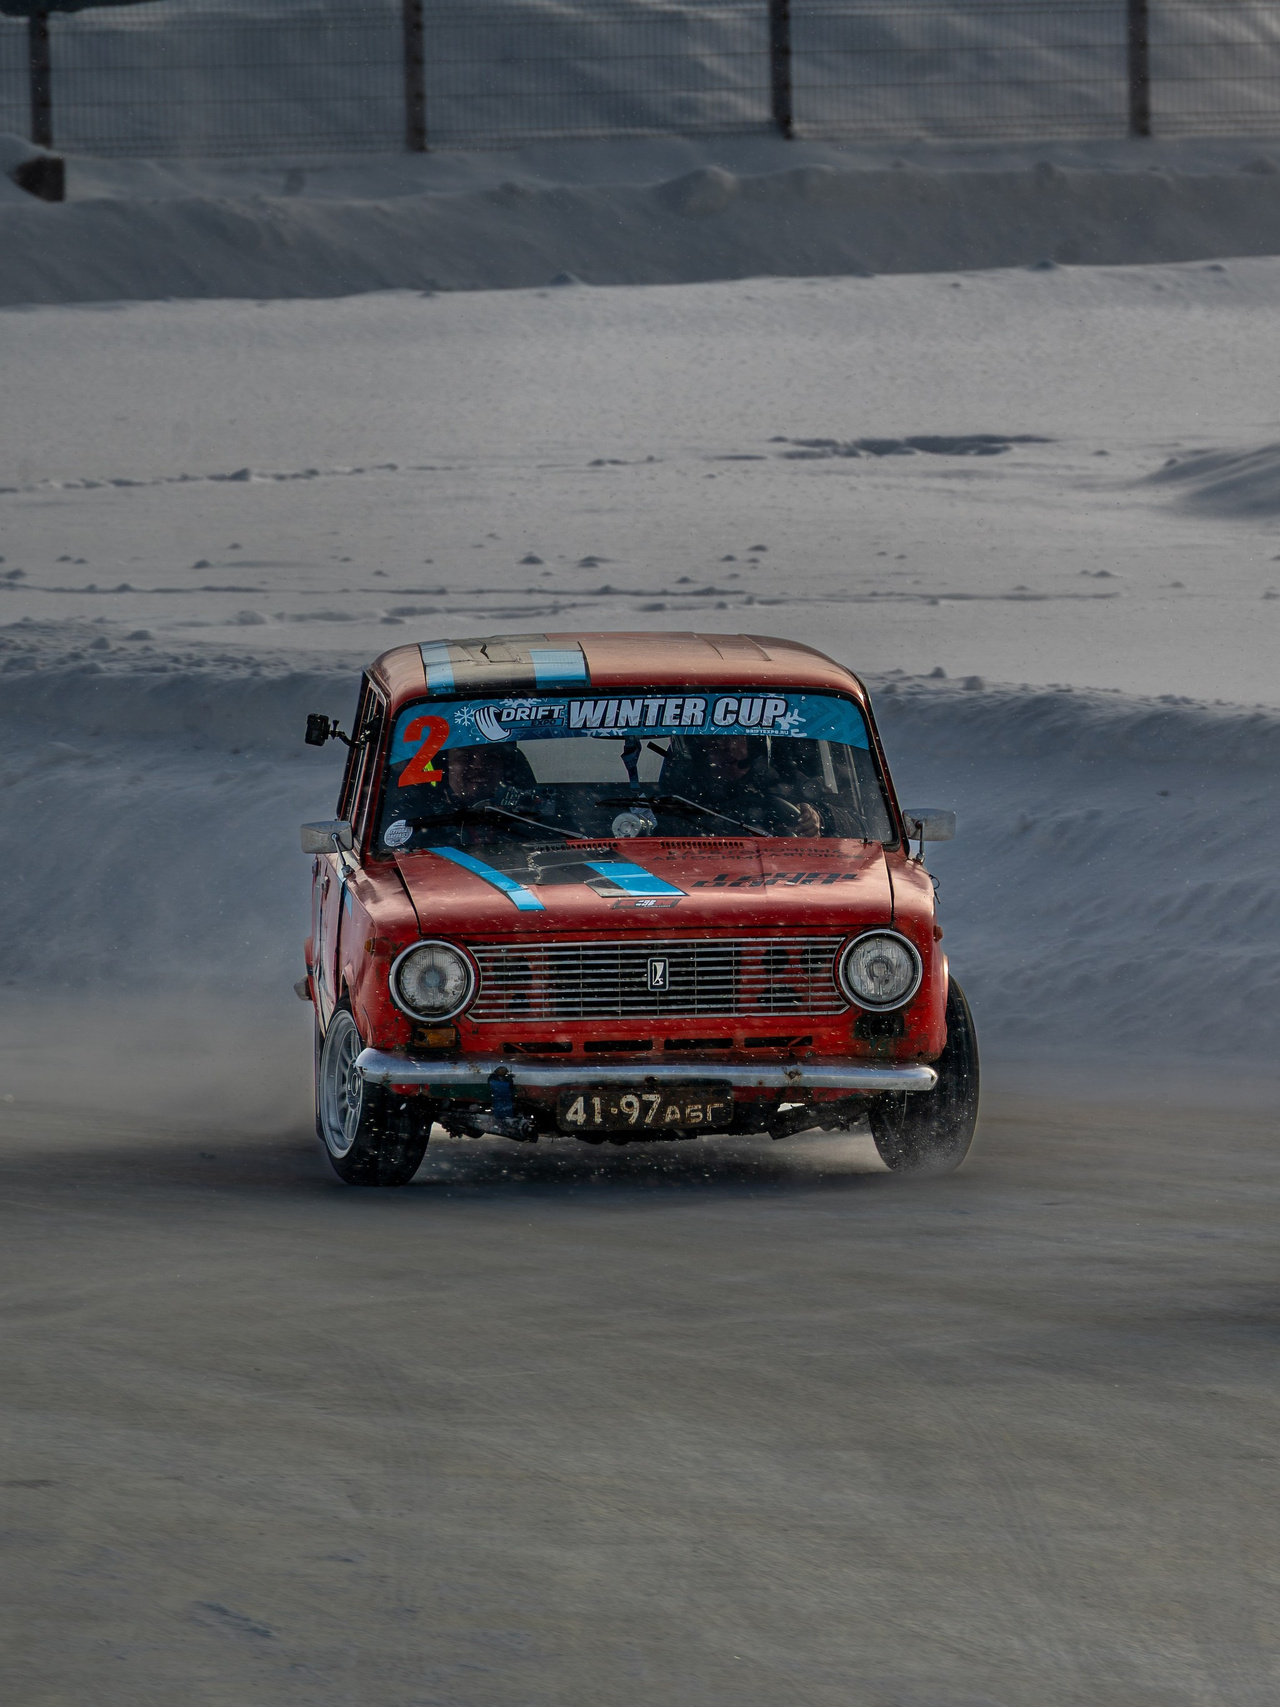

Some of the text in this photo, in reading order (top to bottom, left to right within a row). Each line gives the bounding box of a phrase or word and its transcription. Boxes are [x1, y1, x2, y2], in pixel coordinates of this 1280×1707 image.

[500, 705, 565, 722] DRIFT
[531, 718, 557, 726] EXPO
[569, 697, 787, 729] WINTER CUP
[398, 715, 450, 787] 2
